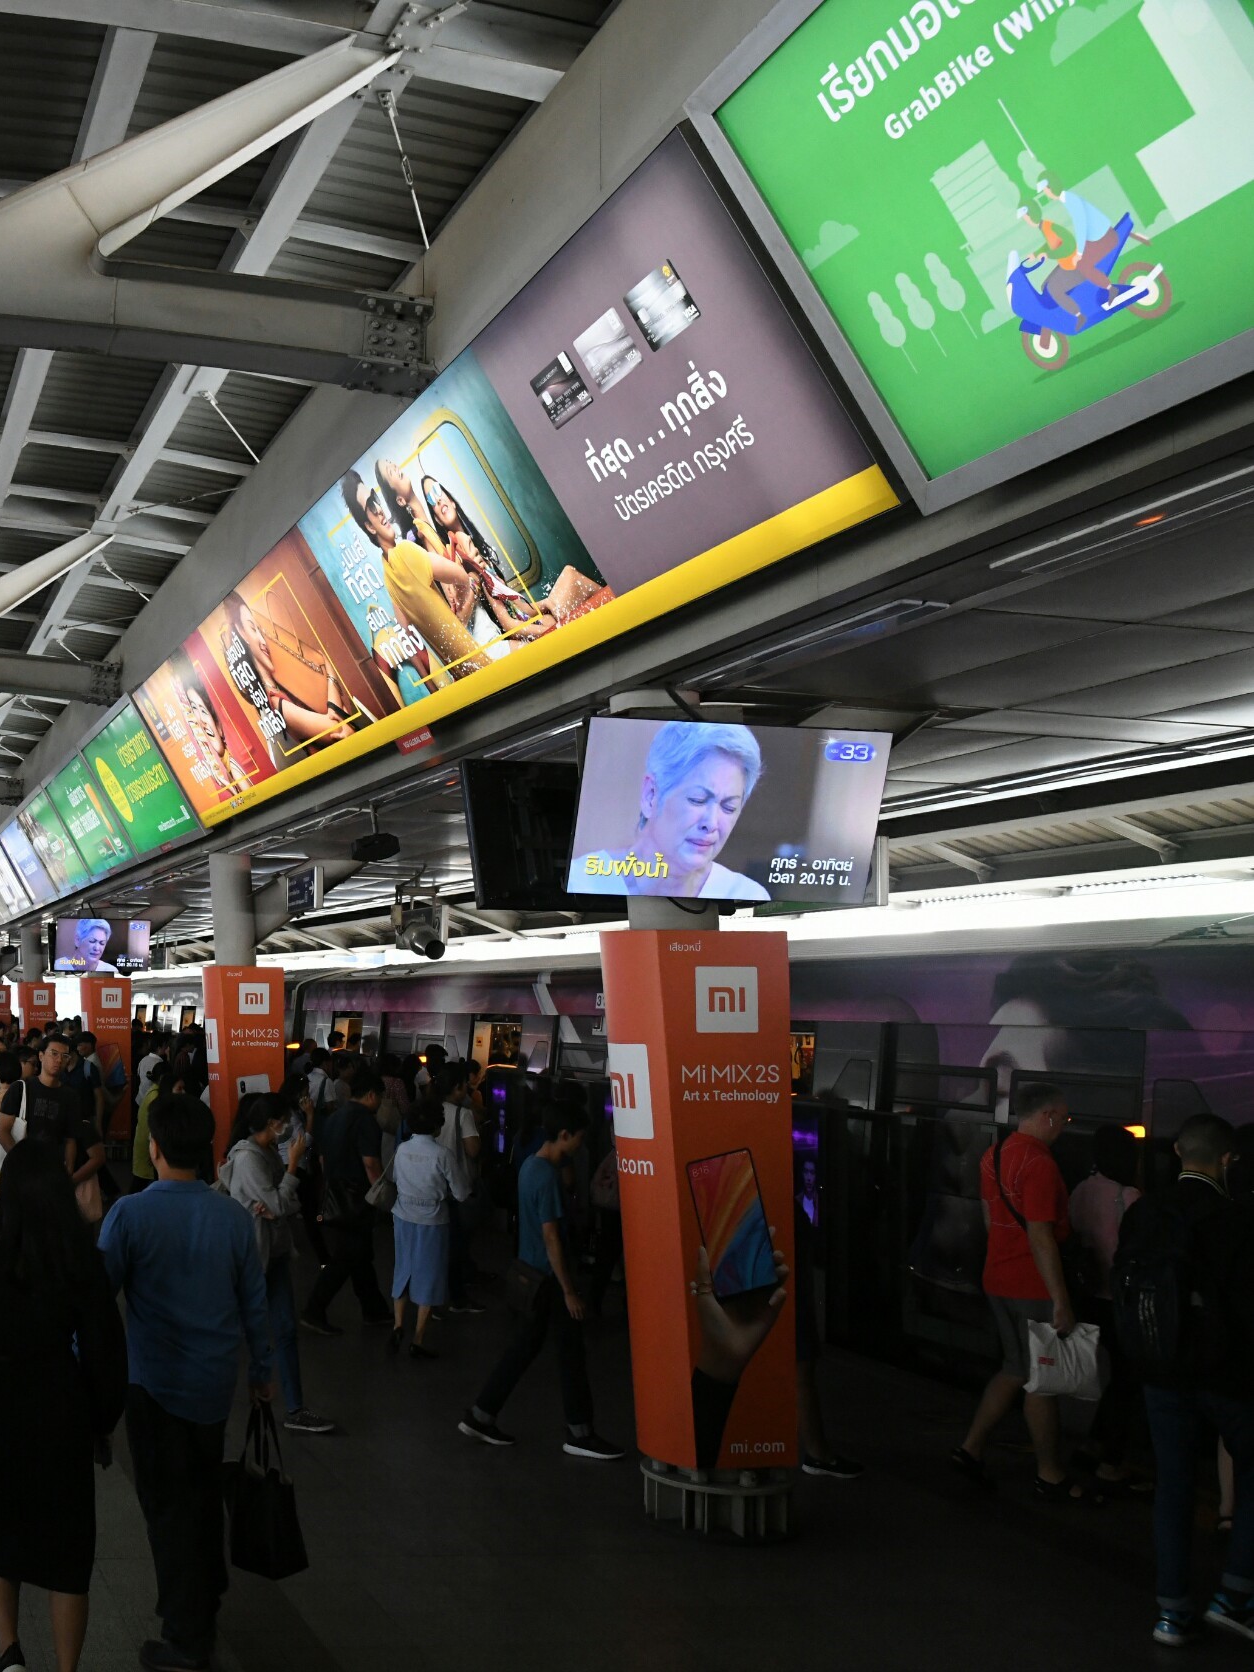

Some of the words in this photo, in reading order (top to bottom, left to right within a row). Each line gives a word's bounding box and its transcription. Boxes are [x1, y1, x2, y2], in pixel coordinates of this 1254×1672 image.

[884, 44, 994, 139] GrabBike
[614, 458, 696, 521] บัตรเครดิต
[693, 414, 755, 472] กรุงศรี
[366, 606, 391, 635] สนุก
[379, 617, 425, 672] ทุกสิ่ง
[839, 743, 868, 760] 33
[584, 852, 669, 880] ริมฝั่งน้ำ
[770, 854, 798, 872] ศุกร์
[812, 856, 853, 872] อาทิตย์
[768, 872, 796, 885] เวลา
[799, 872, 835, 886] 20.15
[839, 874, 852, 887] น.
[231, 1028, 243, 1038] Mi
[245, 1028, 266, 1038] MIX
[267, 1028, 280, 1038] 2S
[681, 1064, 707, 1083] Mi
[711, 1064, 753, 1084] MIX
[756, 1064, 780, 1083] 2S
[682, 1090, 701, 1102] Art
[703, 1093, 710, 1101] x
[713, 1090, 780, 1104] Technology
[730, 1440, 786, 1455] mi.com
